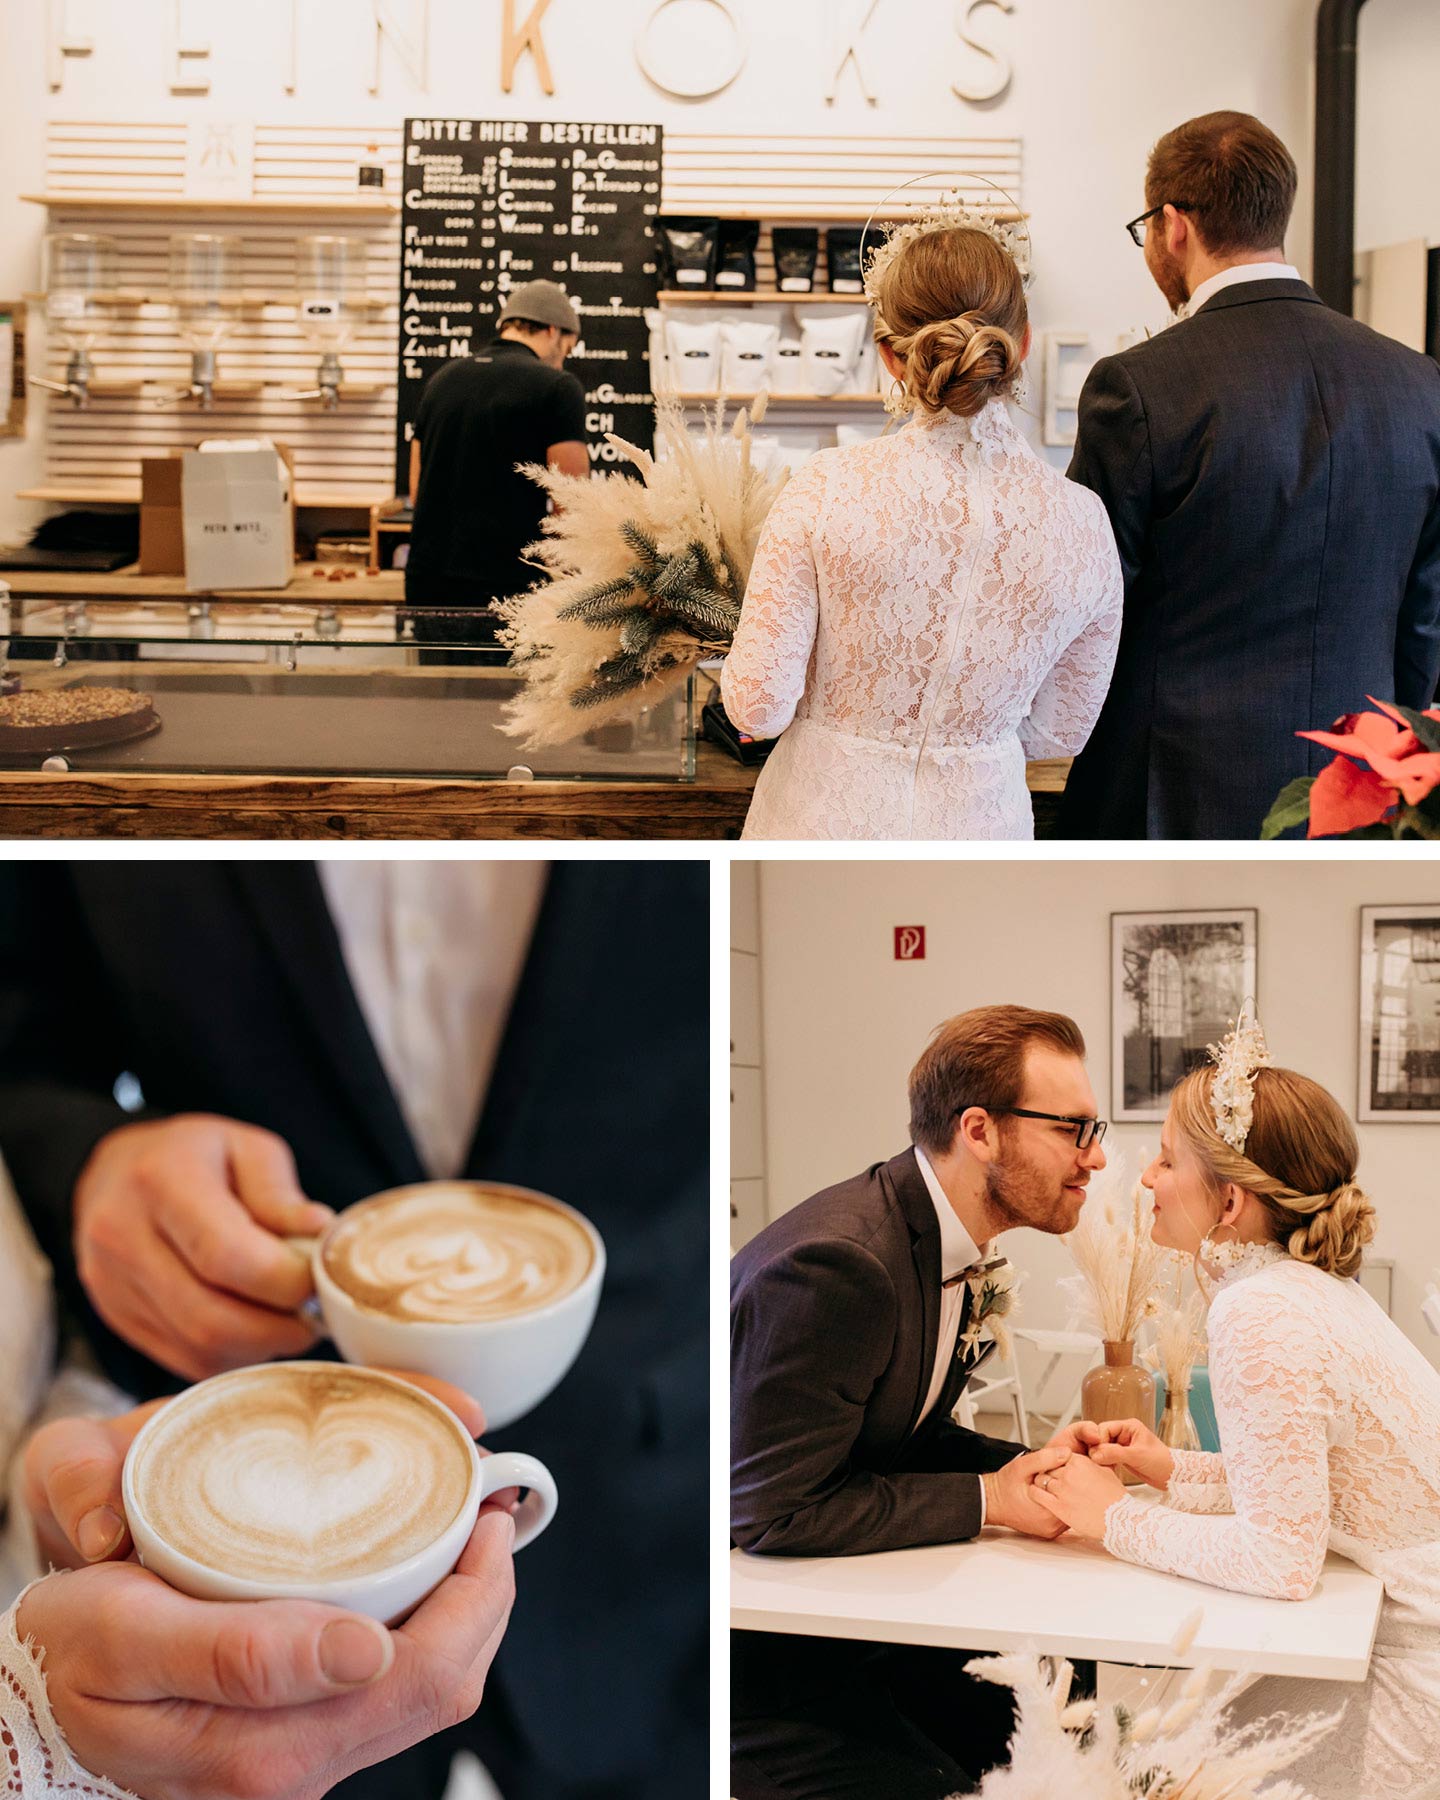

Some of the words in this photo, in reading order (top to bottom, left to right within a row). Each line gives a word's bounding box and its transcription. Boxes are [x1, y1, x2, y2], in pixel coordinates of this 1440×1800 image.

[411, 119, 473, 141] BITTE
[480, 121, 529, 143] HIER
[540, 122, 657, 146] BESTELLEN
